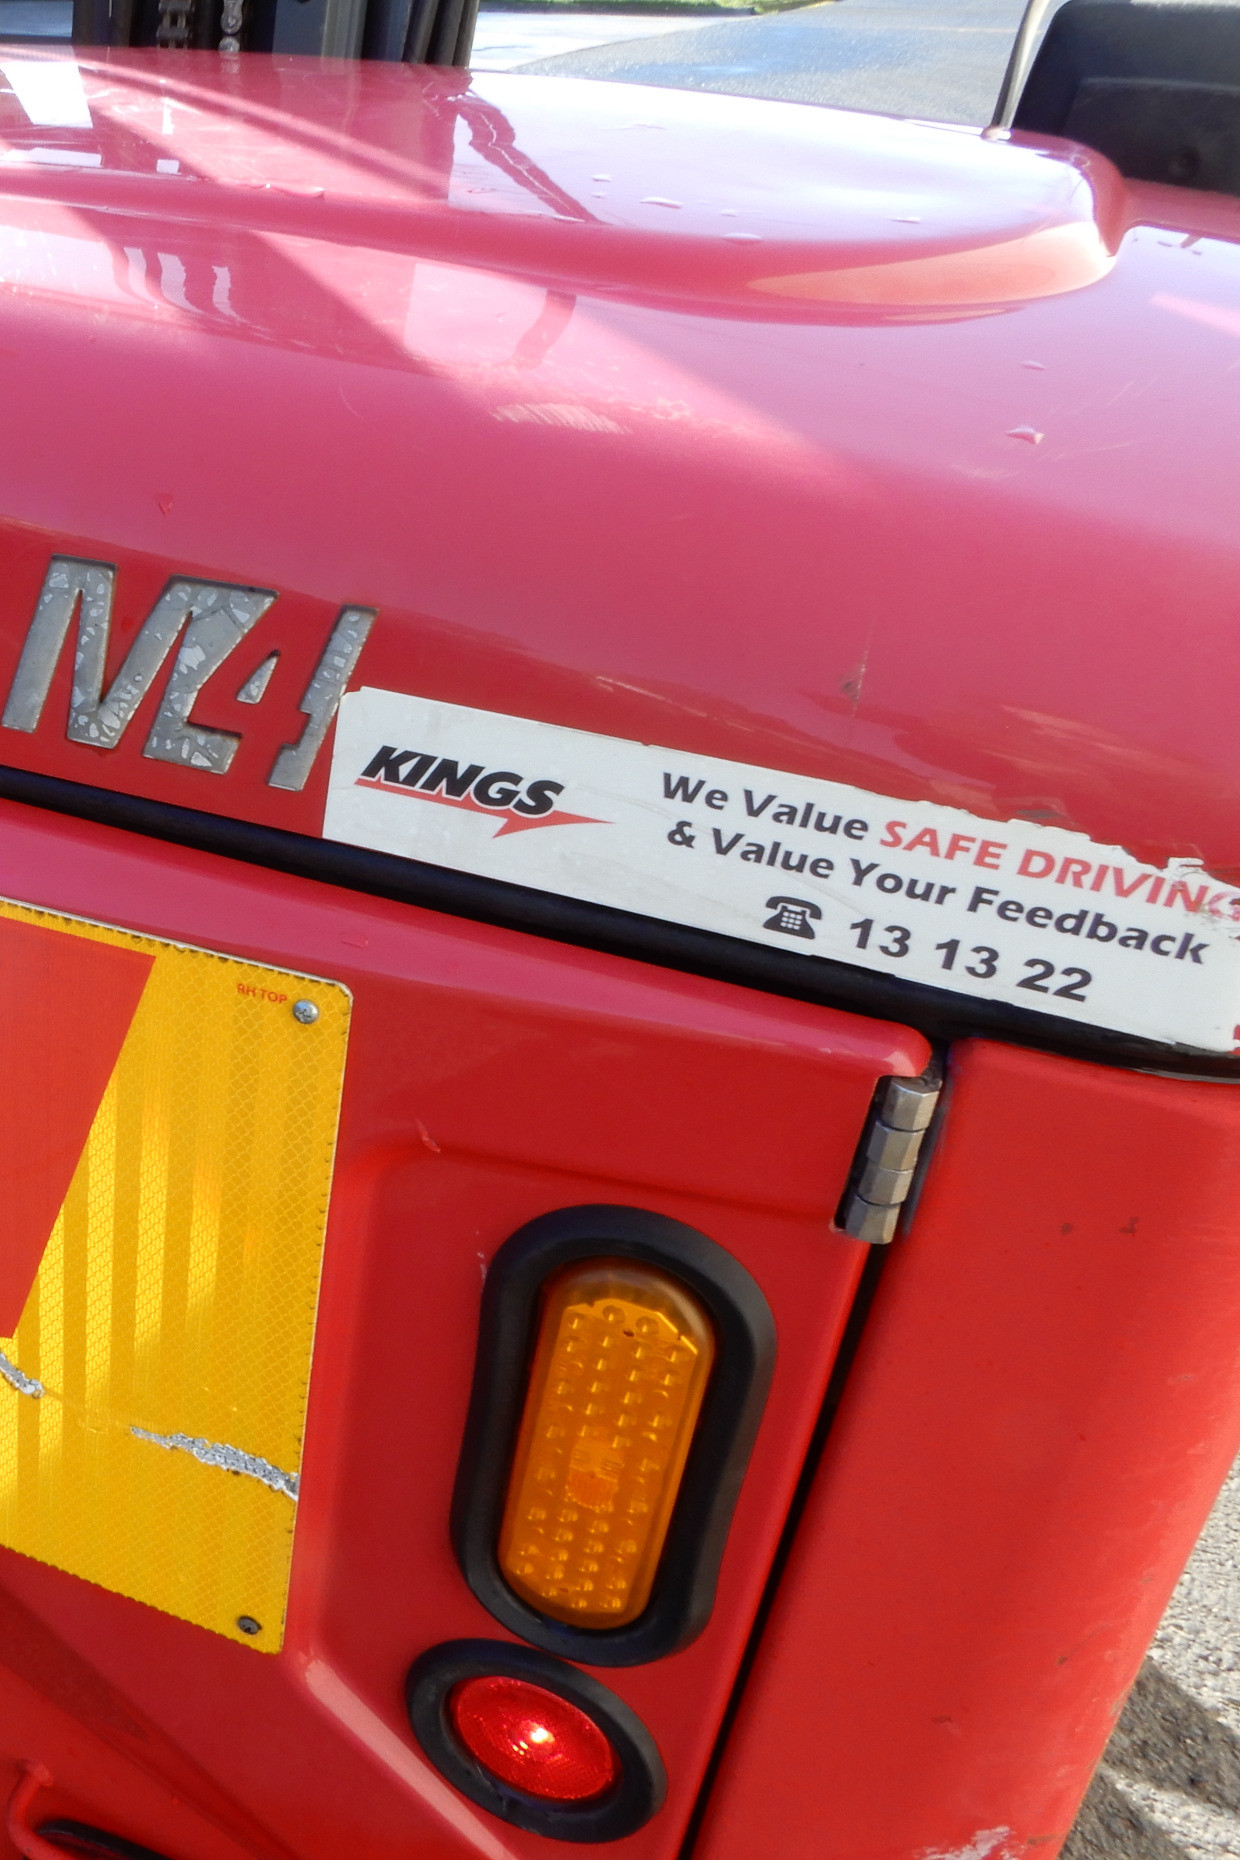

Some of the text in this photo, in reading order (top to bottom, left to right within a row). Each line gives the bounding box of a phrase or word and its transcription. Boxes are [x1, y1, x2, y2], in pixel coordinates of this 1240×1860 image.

[360, 745, 565, 816] KINGS
[663, 772, 729, 811] We
[743, 788, 869, 841] Value
[880, 820, 1008, 870] SAFE
[667, 820, 1210, 964] & Value Your Feedback
[237, 983, 288, 1003] RH TOP
[849, 918, 1093, 1002] 13 13 22
